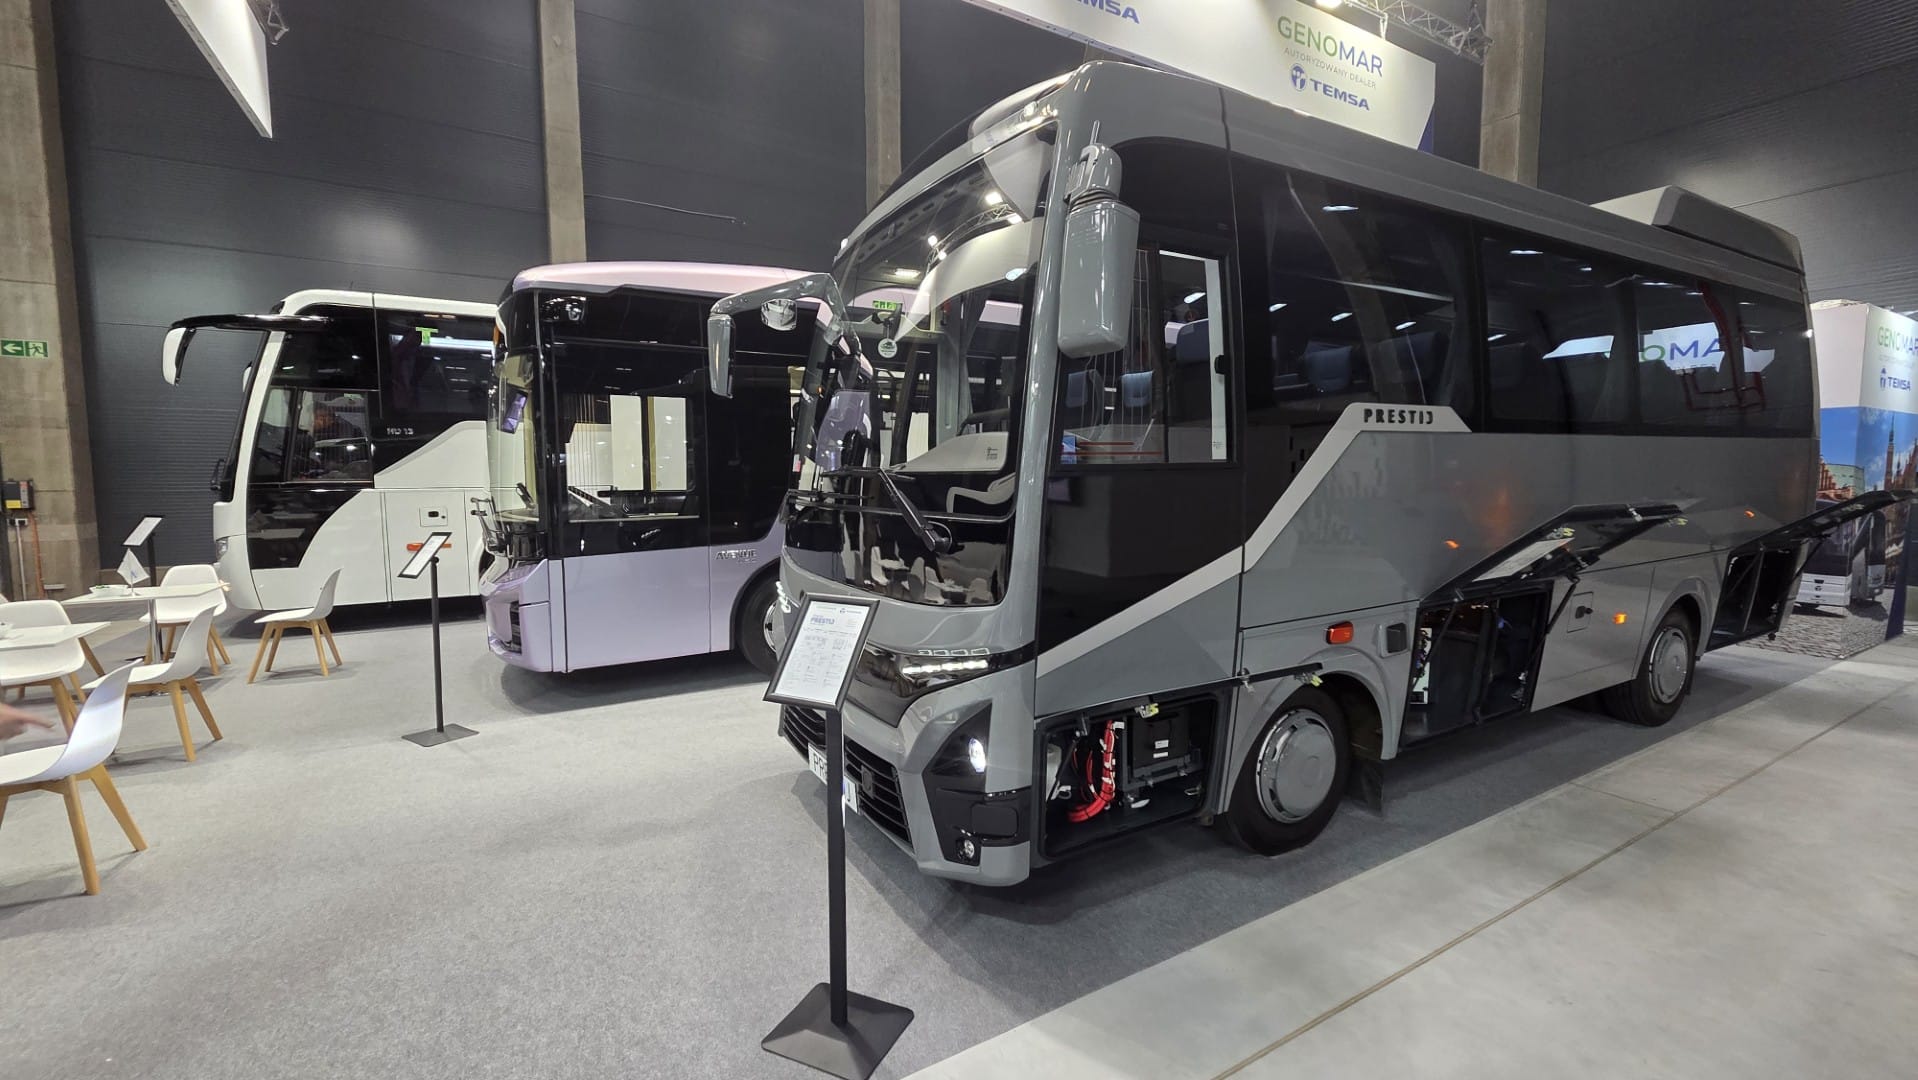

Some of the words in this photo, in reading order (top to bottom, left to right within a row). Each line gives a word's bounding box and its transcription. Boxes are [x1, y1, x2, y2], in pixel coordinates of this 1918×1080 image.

[1277, 15, 1383, 77] GENOMAR
[1283, 47, 1349, 78] AUTORYZOWANY
[1349, 73, 1377, 90] DEALER
[1309, 78, 1370, 111] TEMSA
[1887, 376, 1911, 392] TEMSA
[1363, 408, 1433, 424] PRESTIJ
